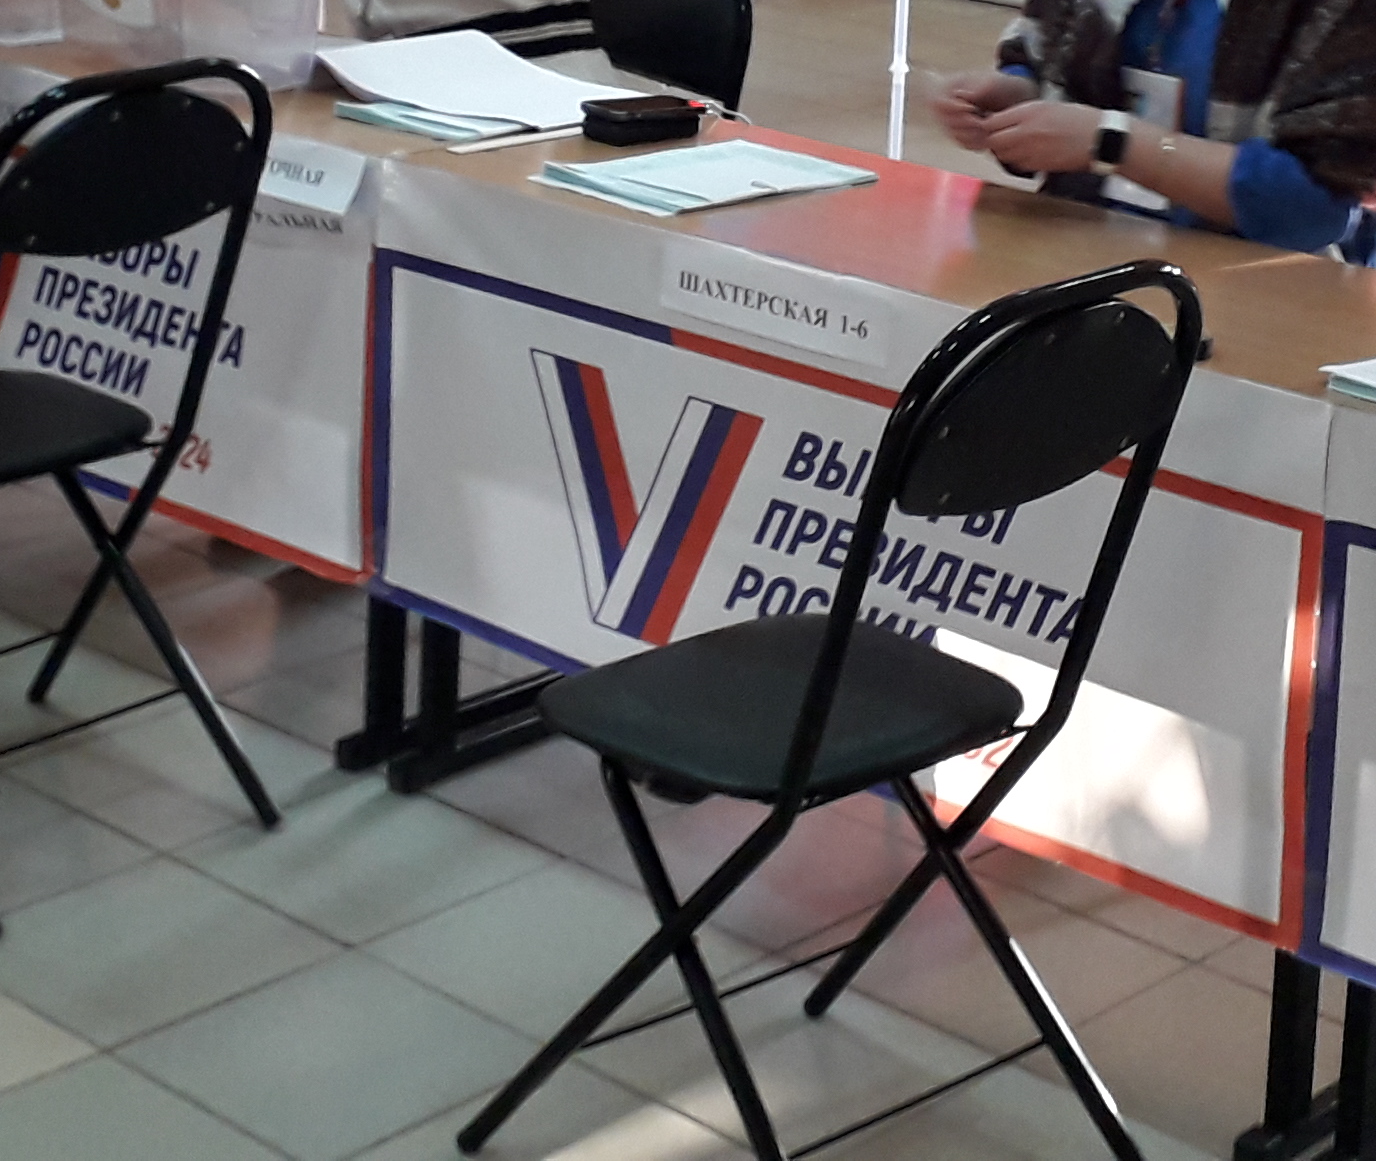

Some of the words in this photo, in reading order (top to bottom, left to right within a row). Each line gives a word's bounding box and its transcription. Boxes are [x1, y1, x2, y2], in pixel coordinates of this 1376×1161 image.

[33, 264, 246, 369] ПРЕЗИДЕНА
[679, 271, 828, 329] ШАХТЕРСКАЯ
[840, 315, 869, 339] 1-6
[15, 319, 151, 399] РОССИИ
